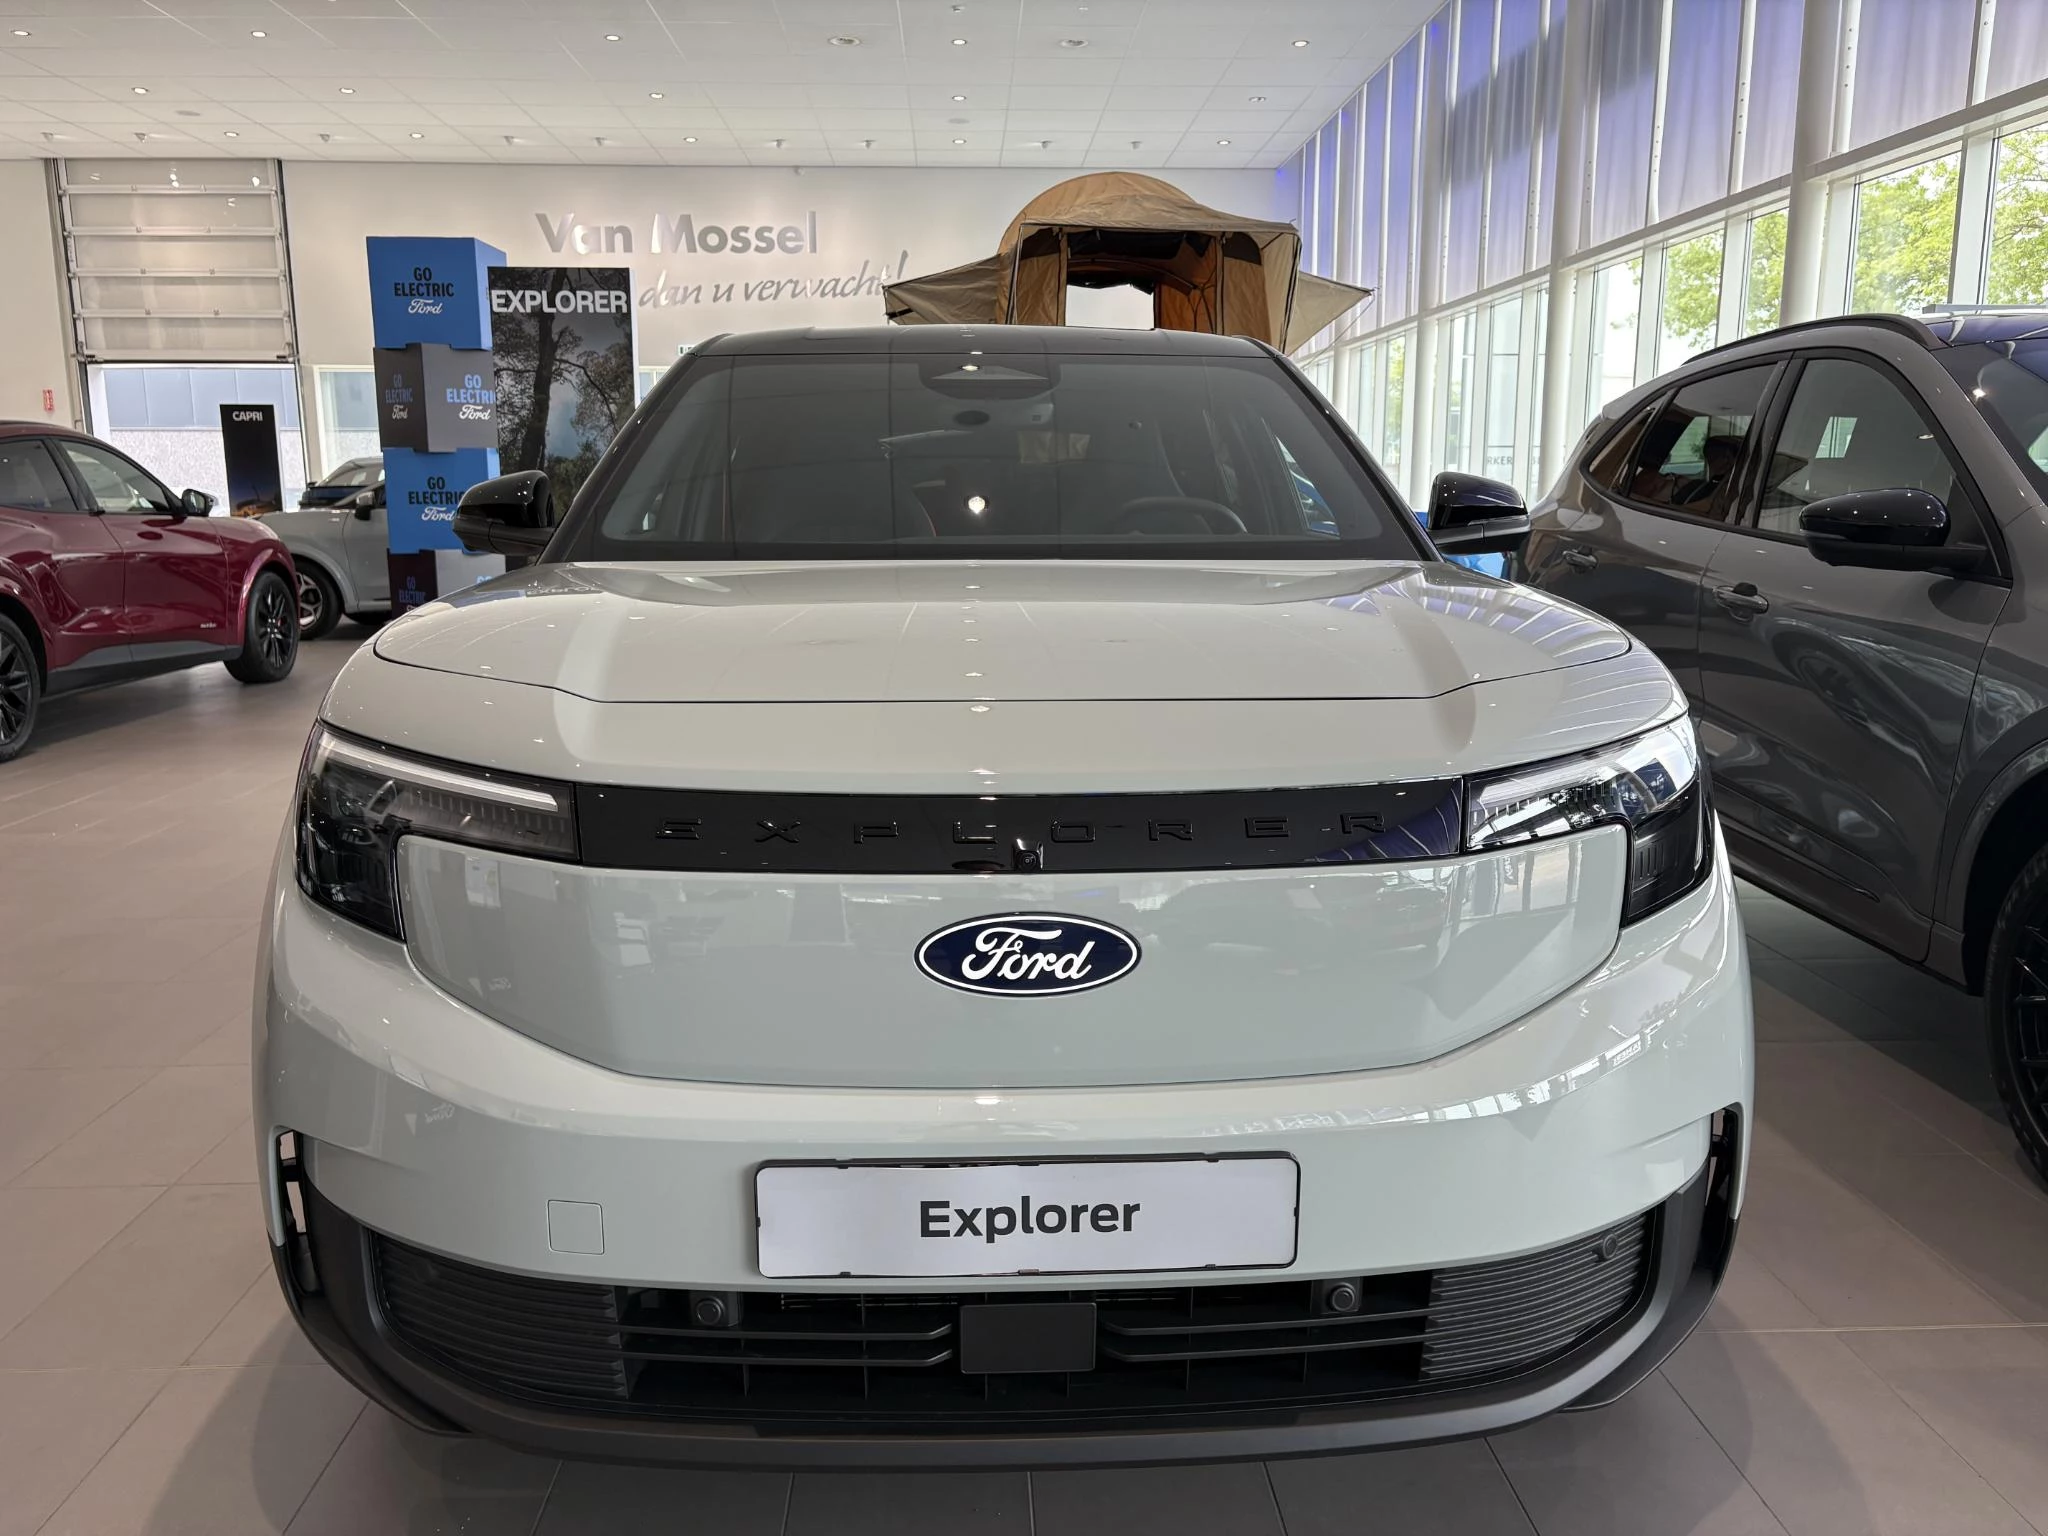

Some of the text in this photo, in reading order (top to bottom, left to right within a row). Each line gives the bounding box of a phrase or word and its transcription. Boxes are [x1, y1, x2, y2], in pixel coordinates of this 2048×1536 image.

[535, 211, 818, 254] Van Mossel
[413, 267, 432, 281] GO
[394, 282, 455, 297] ELECTRIC
[638, 270, 702, 308] dan
[713, 286, 733, 303] u
[408, 298, 443, 314] Ford
[491, 290, 628, 314] EXPLORER
[393, 374, 402, 387] GO
[464, 374, 482, 388] GO
[446, 388, 496, 404] ELECTRI
[232, 411, 264, 421] CAPRI
[392, 404, 408, 419] Ford
[459, 404, 491, 420] Ford
[427, 476, 446, 490] GO
[421, 506, 456, 521] Ford
[655, 811, 1386, 845] EXPLORER
[961, 927, 1095, 980] Ford
[920, 1195, 1141, 1243] Explorer
